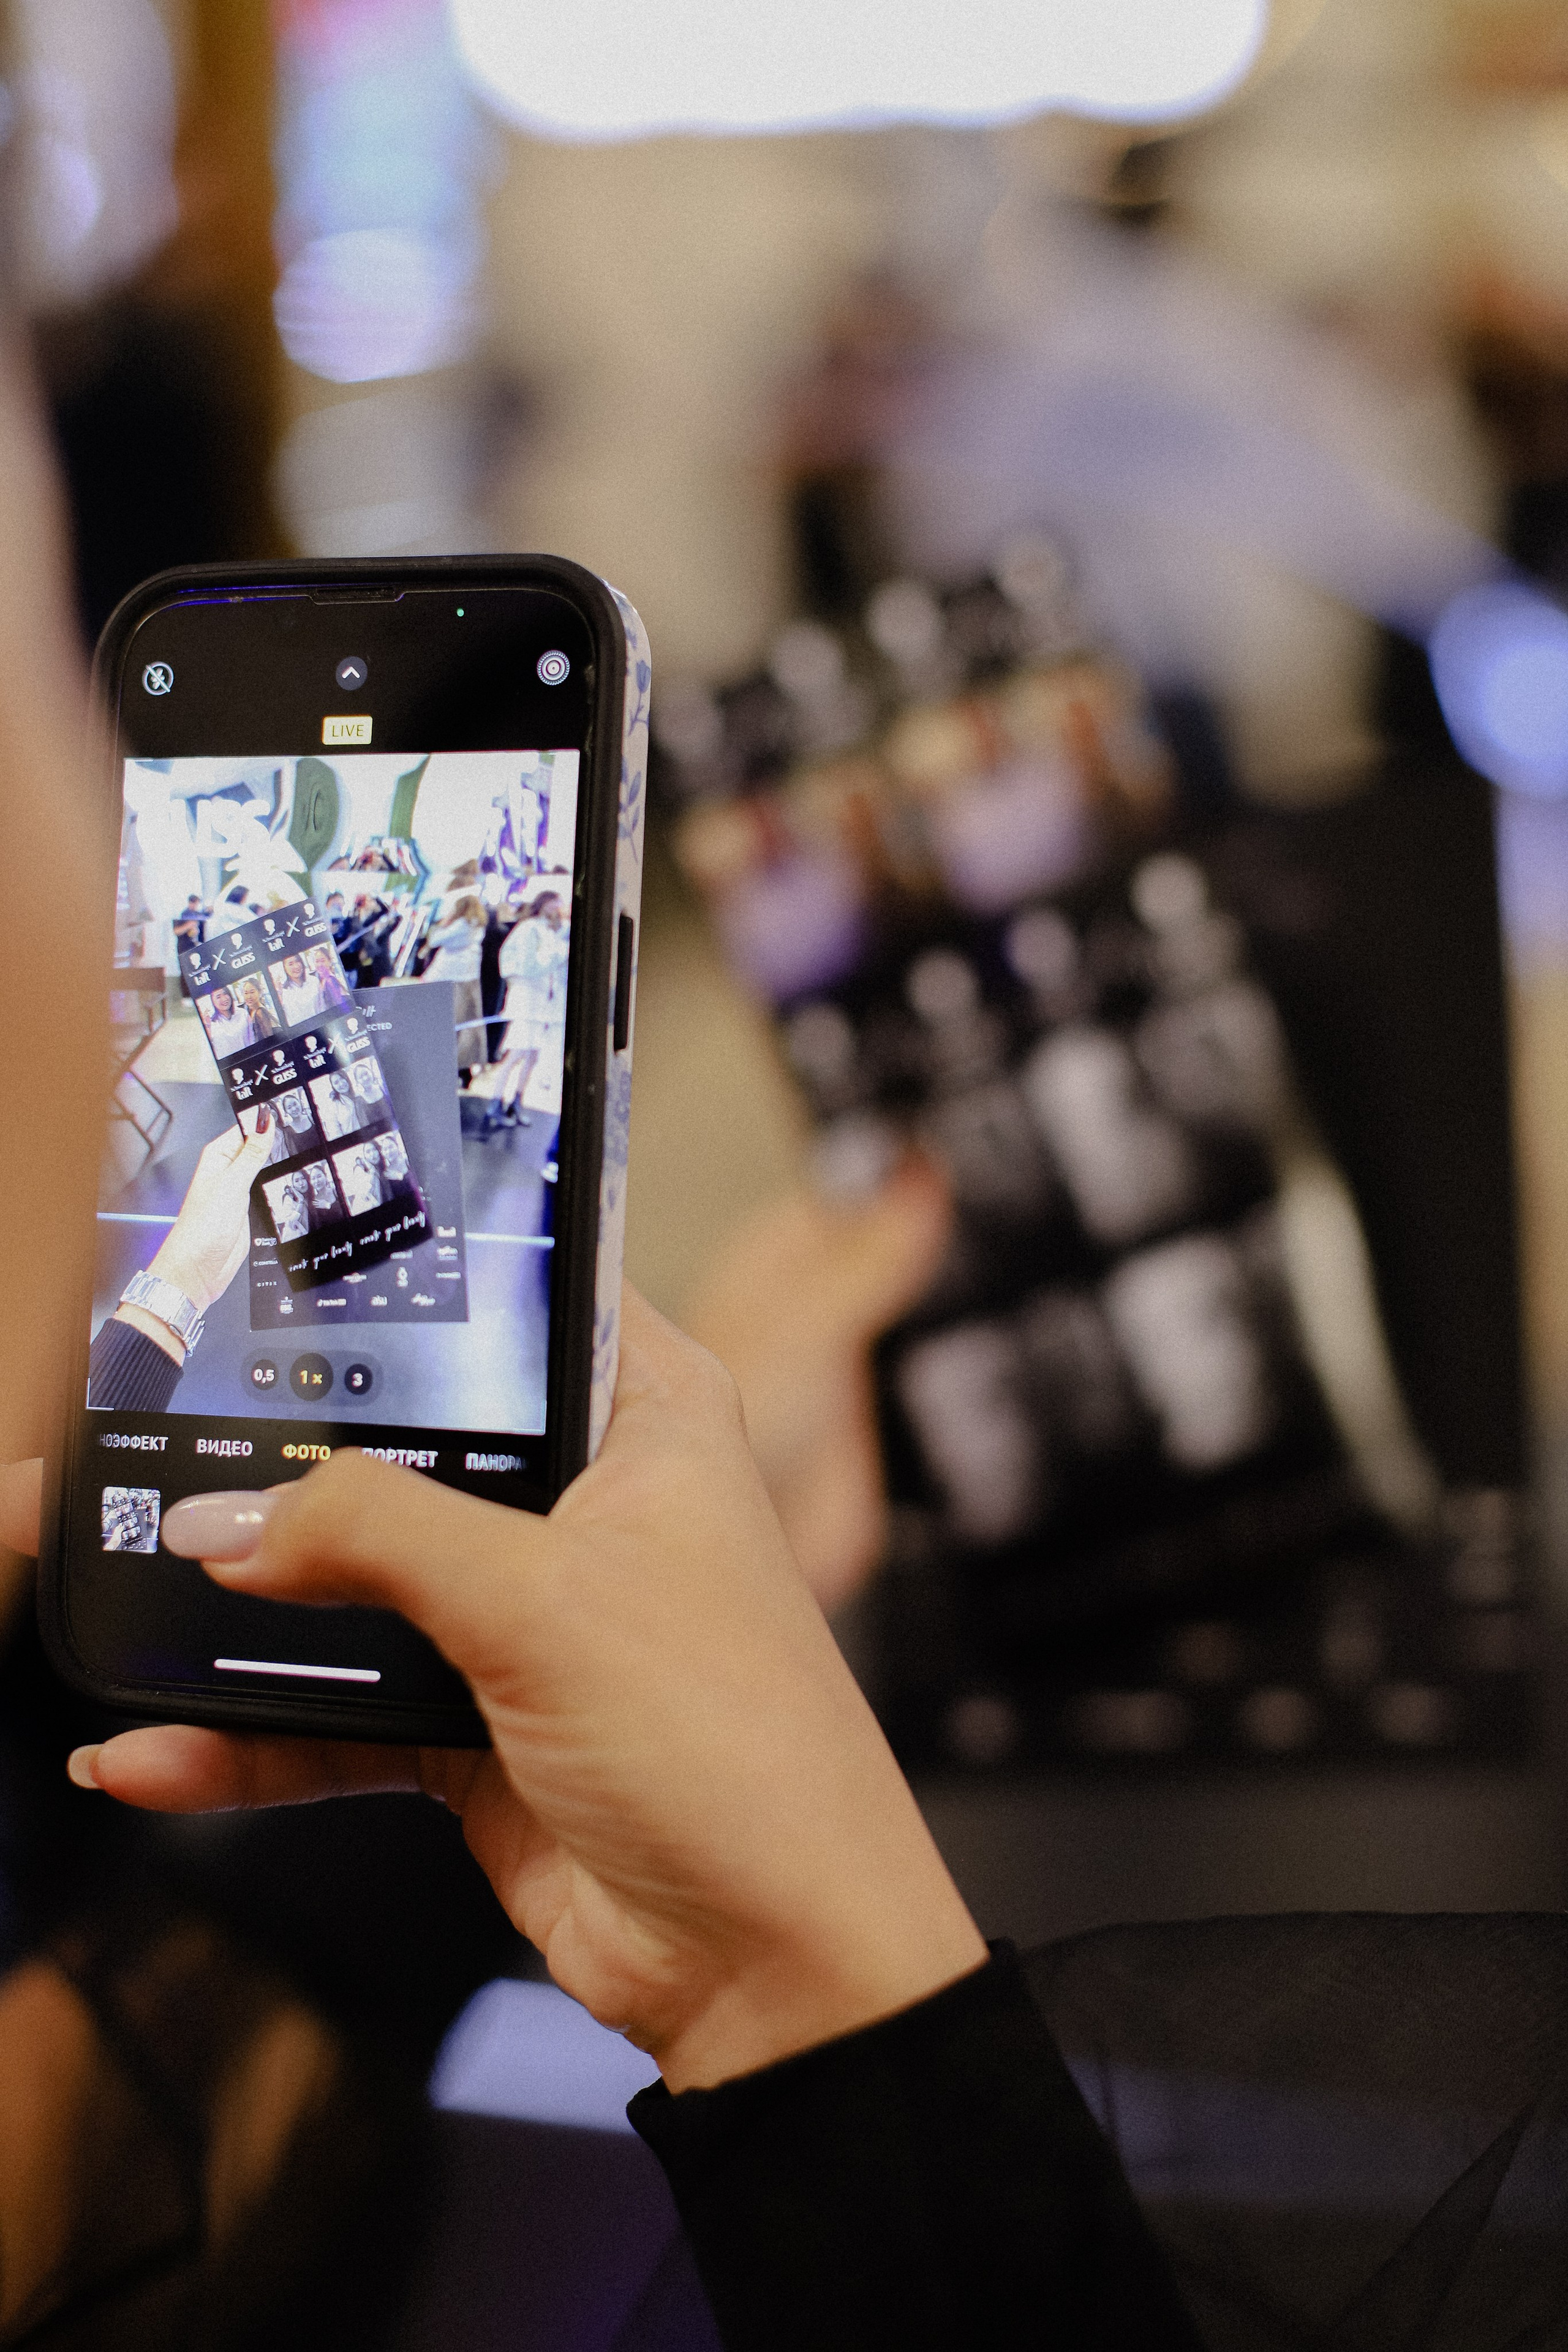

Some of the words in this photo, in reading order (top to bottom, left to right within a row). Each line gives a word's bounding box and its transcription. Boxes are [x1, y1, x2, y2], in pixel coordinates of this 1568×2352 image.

[331, 724, 365, 737] LIVE
[366, 1022, 393, 1031] ECTED
[253, 1368, 275, 1384] 0,5
[352, 1372, 364, 1387] 3
[195, 1439, 254, 1458] ВИДЕО
[281, 1443, 332, 1461] ФОТО
